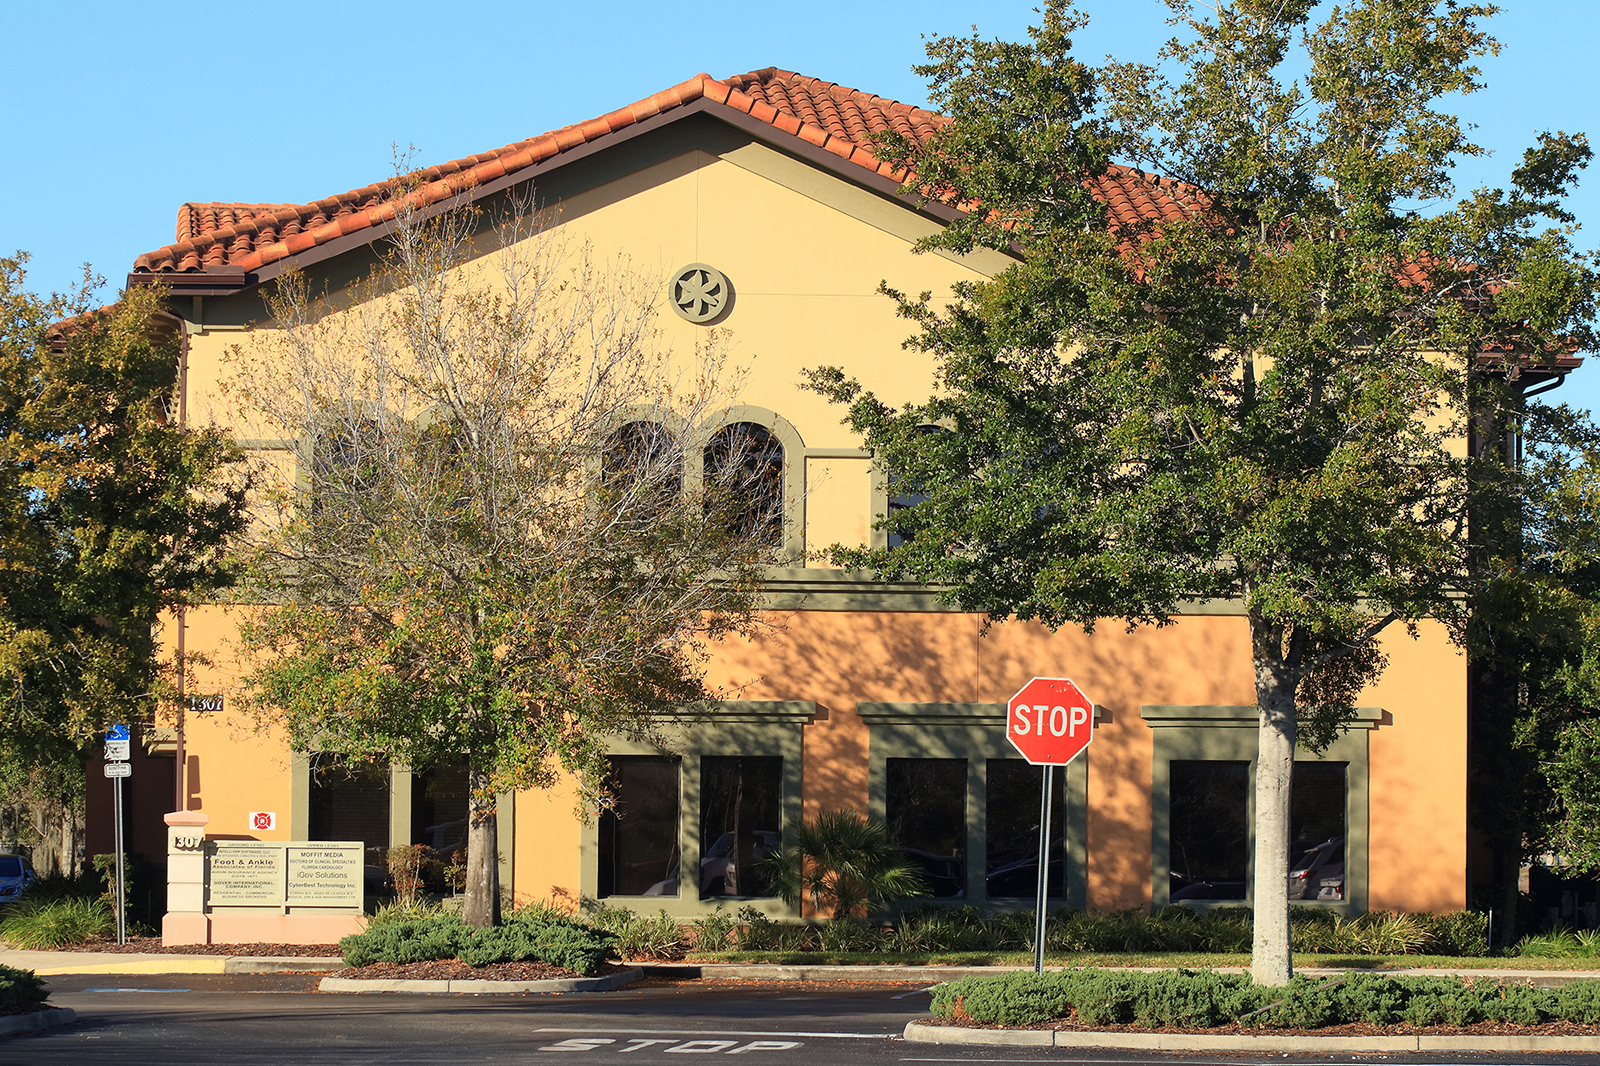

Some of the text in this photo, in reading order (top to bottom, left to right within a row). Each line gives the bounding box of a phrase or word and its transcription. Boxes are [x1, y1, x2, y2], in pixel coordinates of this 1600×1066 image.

[1013, 704, 1087, 737] STOP
[174, 837, 203, 848] 1307
[538, 1038, 804, 1054] STOP
